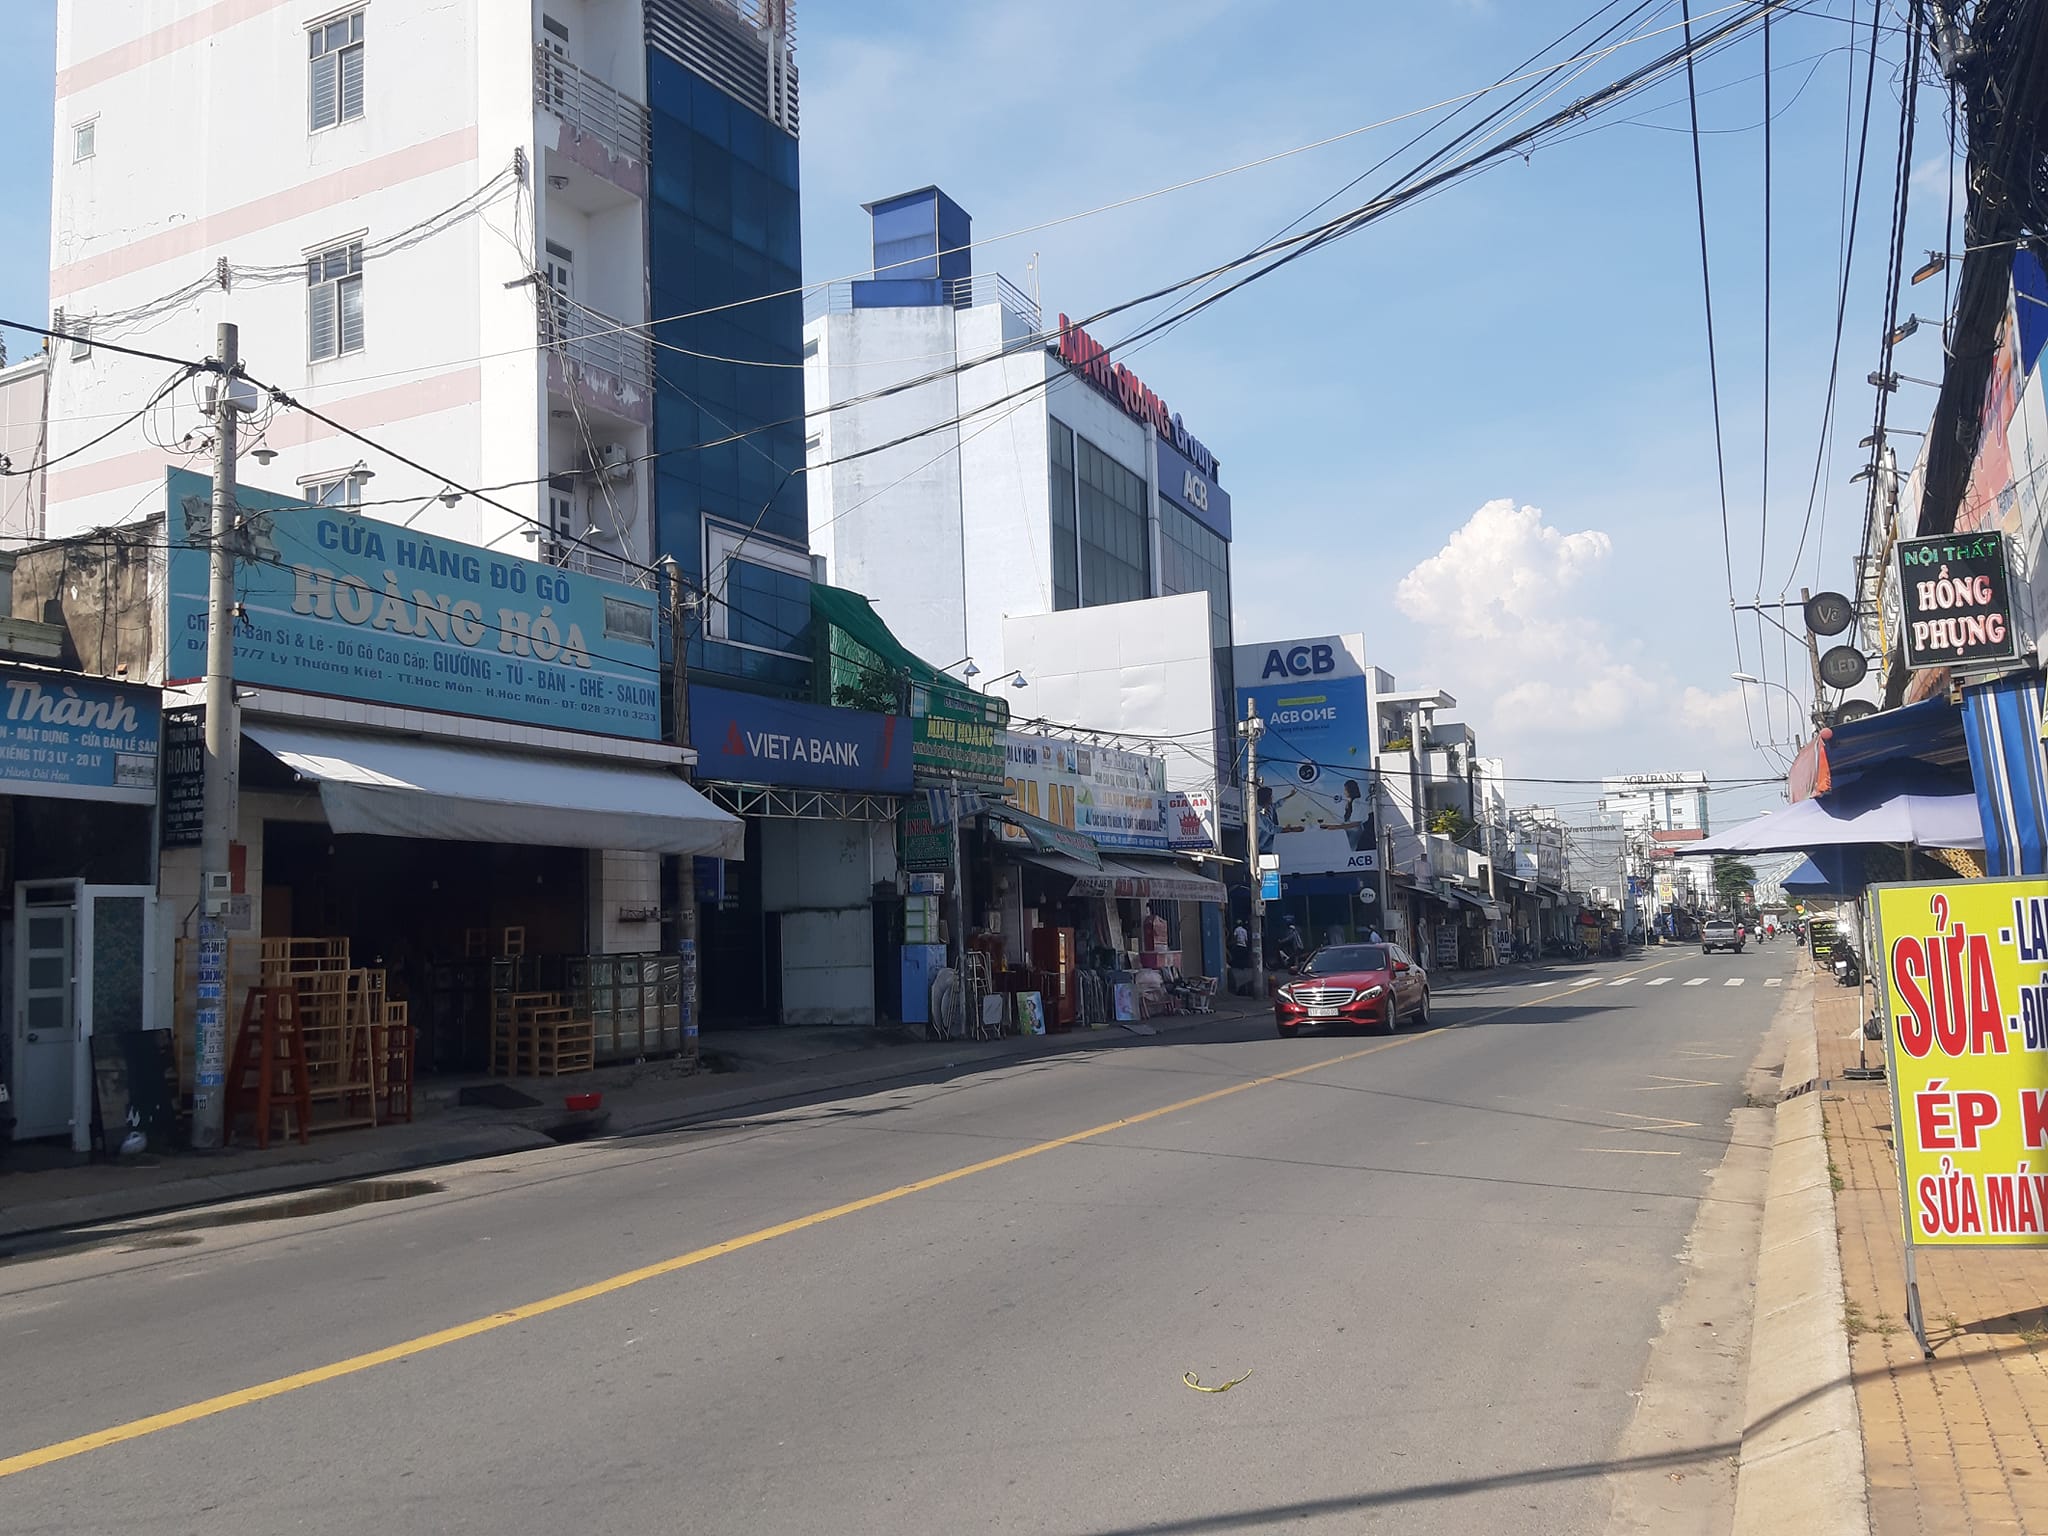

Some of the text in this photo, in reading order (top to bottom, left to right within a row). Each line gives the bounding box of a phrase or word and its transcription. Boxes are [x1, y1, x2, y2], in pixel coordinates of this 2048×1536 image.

[1183, 470, 1207, 512] ACB
[316, 517, 571, 605] CỬA HÀNG ĐỒ GỖ
[1904, 538, 1996, 567] NỘI THẤT
[1916, 564, 1993, 612] HỒNG
[290, 562, 592, 669] HOÀNG HÓA
[1912, 613, 2007, 656] PHỤNG
[377, 647, 400, 665] Cao
[433, 651, 492, 680] GIƯỜNG
[506, 660, 524, 686] TỦ
[537, 667, 566, 693] BÀN
[580, 674, 605, 699] GHẾ
[616, 684, 657, 708] SALON
[1261, 644, 1336, 679] ACB
[1829, 657, 1858, 675] LED
[5, 679, 139, 733] Thành
[580, 702, 600, 713] 028
[603, 706, 629, 719] 3710
[745, 730, 860, 768] VIET A BANK
[927, 714, 994, 748] MINH HOÀNG
[47, 750, 55, 763] 3
[57, 751, 68, 764] LY
[91, 755, 103, 768] LY
[167, 744, 200, 774] HOÀNG
[1169, 798, 1208, 809] GIA AN
[1566, 823, 1617, 834] Vietcombank
[1347, 855, 1373, 868] ACB
[1893, 893, 2008, 1058] SỬA
[1915, 1080, 1999, 1150] ÉP
[1918, 1157, 1982, 1235] SỬA
